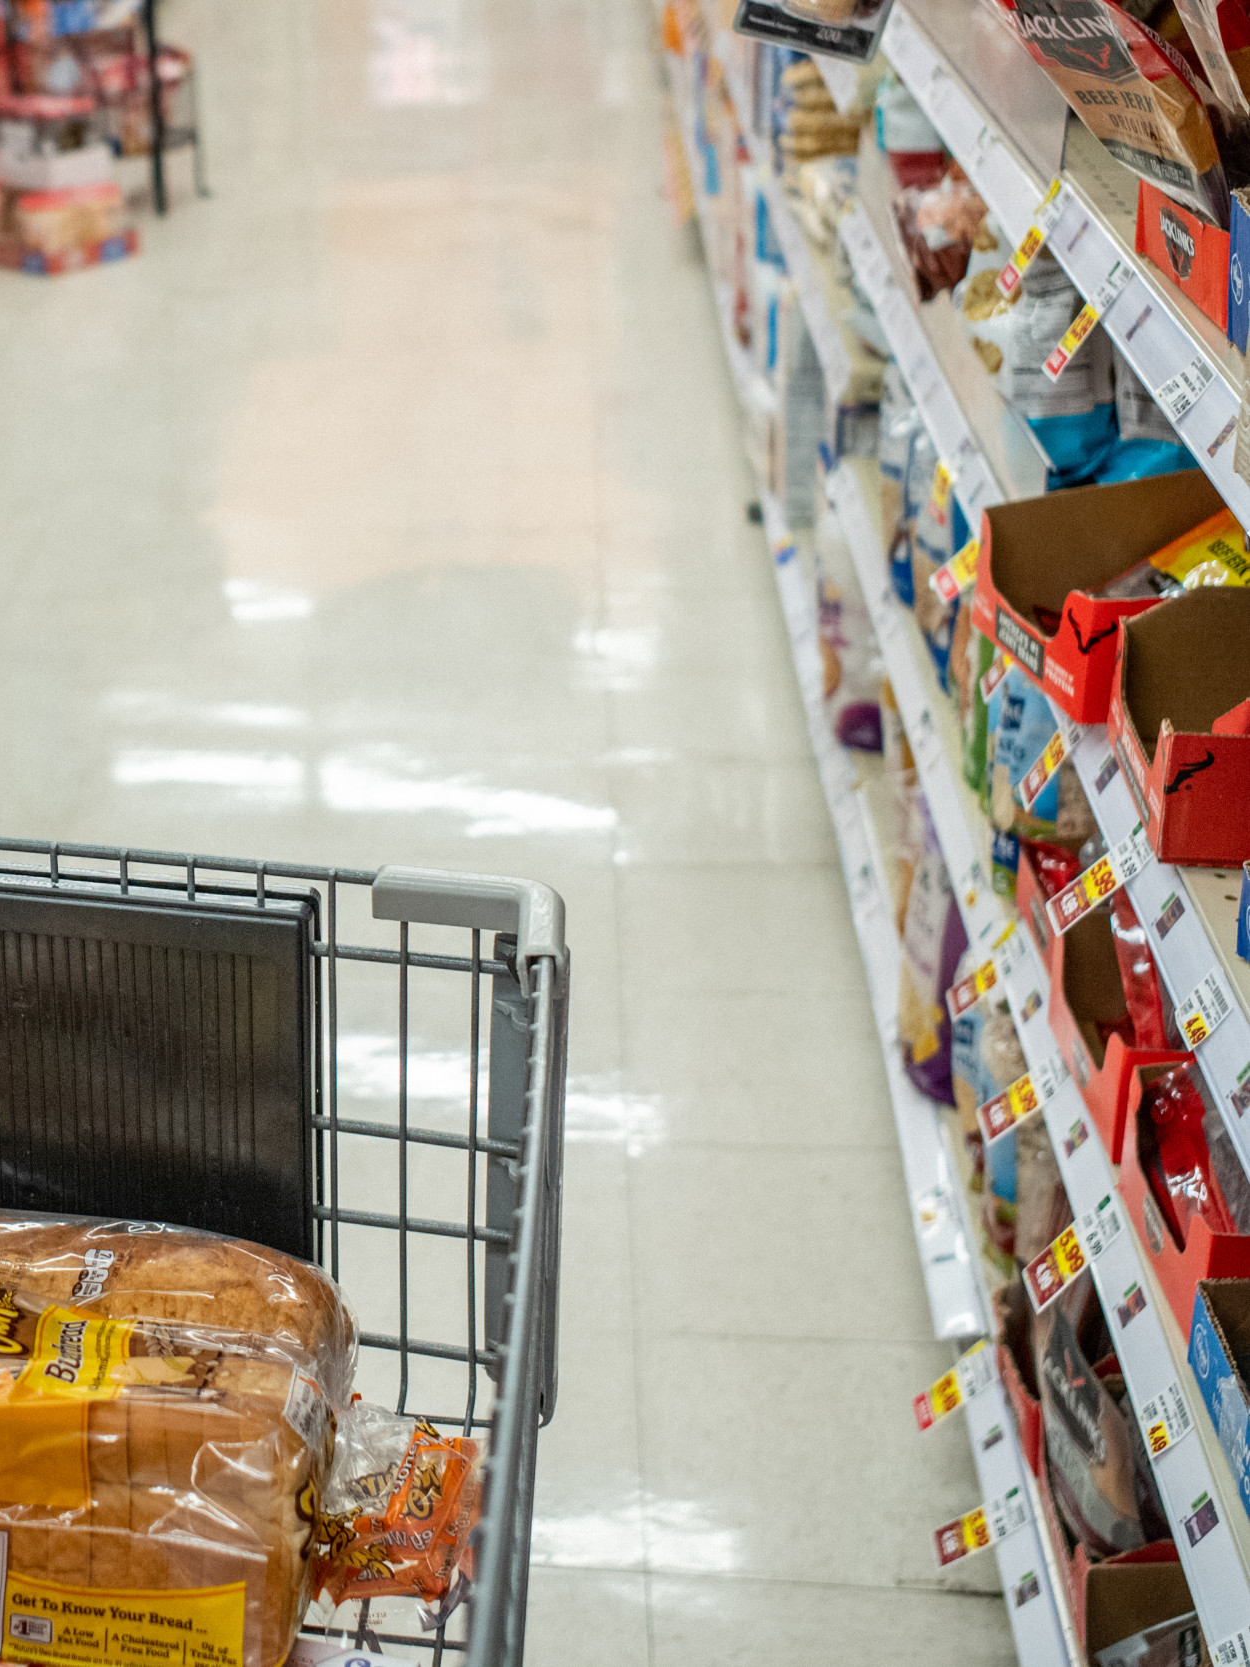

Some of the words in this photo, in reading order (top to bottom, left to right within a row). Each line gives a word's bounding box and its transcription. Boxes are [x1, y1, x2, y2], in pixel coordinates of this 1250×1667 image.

[1075, 89, 1119, 106] BEEF
[1090, 859, 1117, 896] 5.99
[1185, 1017, 1207, 1045] 4.49
[1059, 1228, 1085, 1273] 5.99
[1148, 1424, 1167, 1453] 4.49
[12, 1593, 37, 1608] Get
[40, 1597, 58, 1612] To
[61, 1601, 106, 1617] Know
[110, 1606, 146, 1622] Your
[149, 1612, 193, 1631] Bread
[57, 1634, 73, 1645] Fat
[76, 1637, 99, 1648] Food
[73, 1627, 94, 1638] Low
[121, 1633, 180, 1650] Cholesterol
[120, 1644, 144, 1655] Free
[145, 1647, 170, 1659] Food
